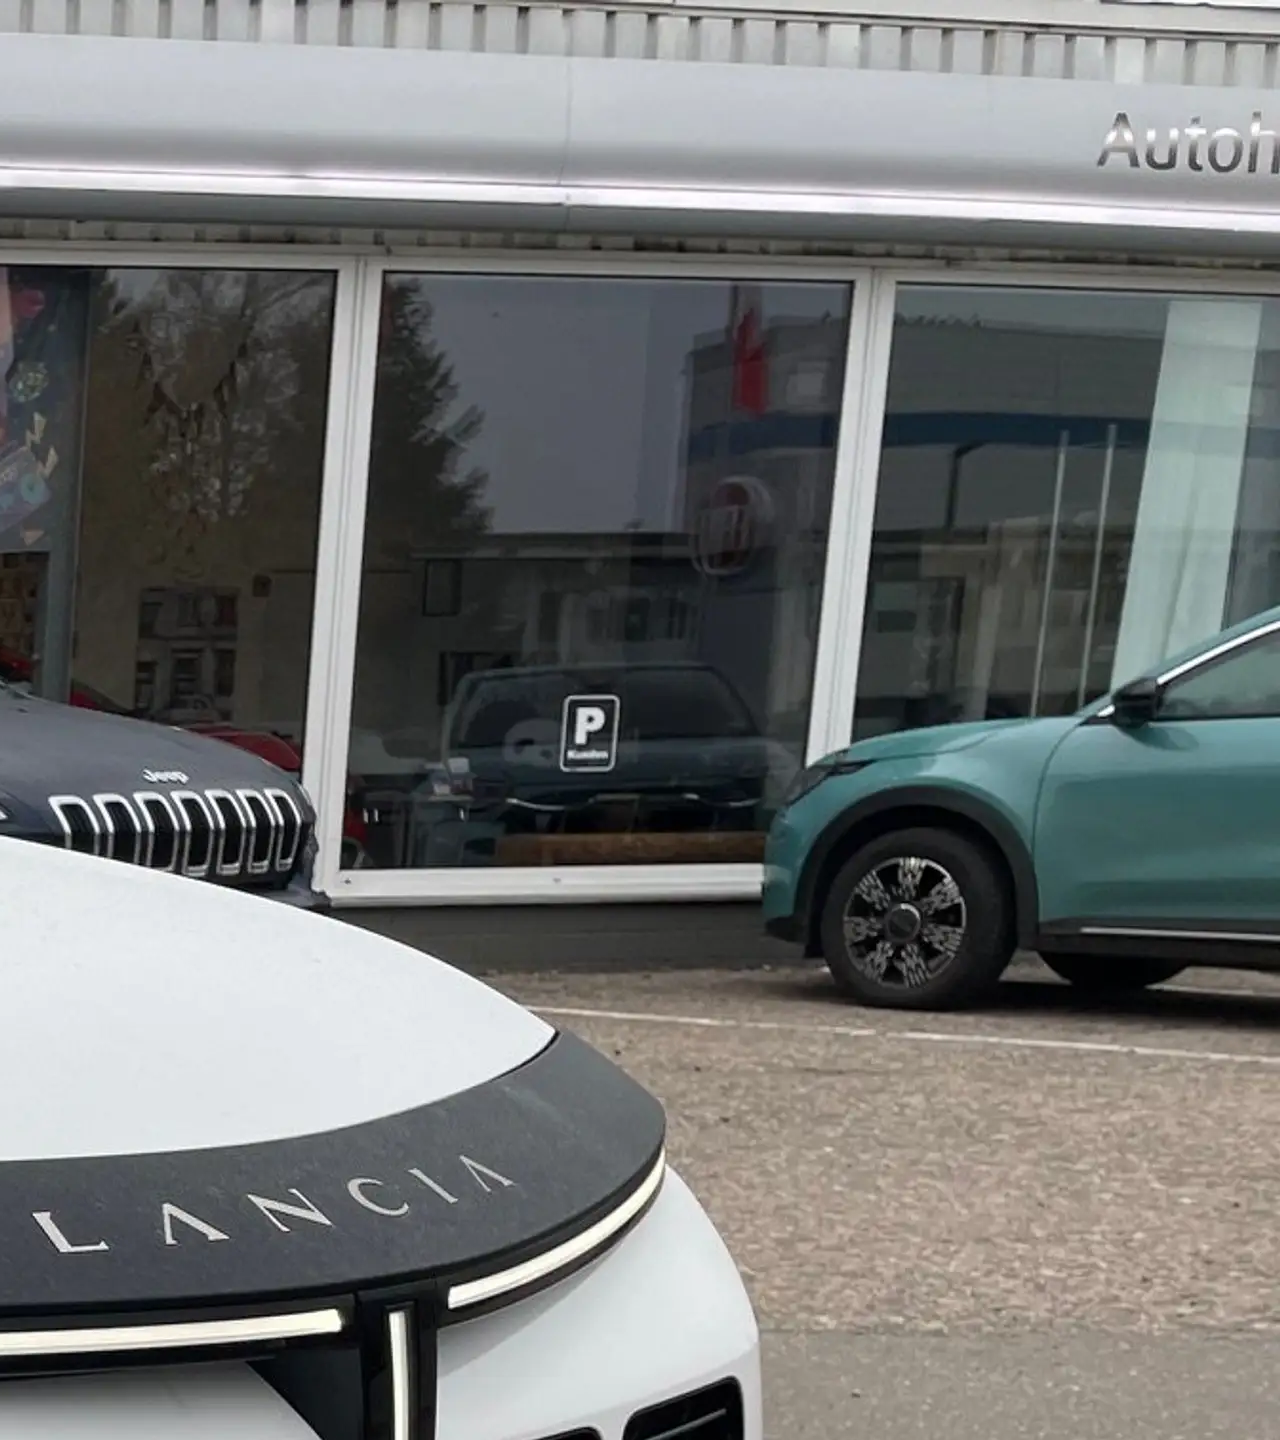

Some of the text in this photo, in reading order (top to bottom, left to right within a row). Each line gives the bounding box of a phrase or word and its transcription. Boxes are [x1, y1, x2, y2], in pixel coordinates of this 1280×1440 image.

[1096, 110, 1280, 174] Autoh
[574, 706, 606, 745] P
[142, 768, 190, 784] Jeep
[31, 1153, 516, 1253] LANCIA
